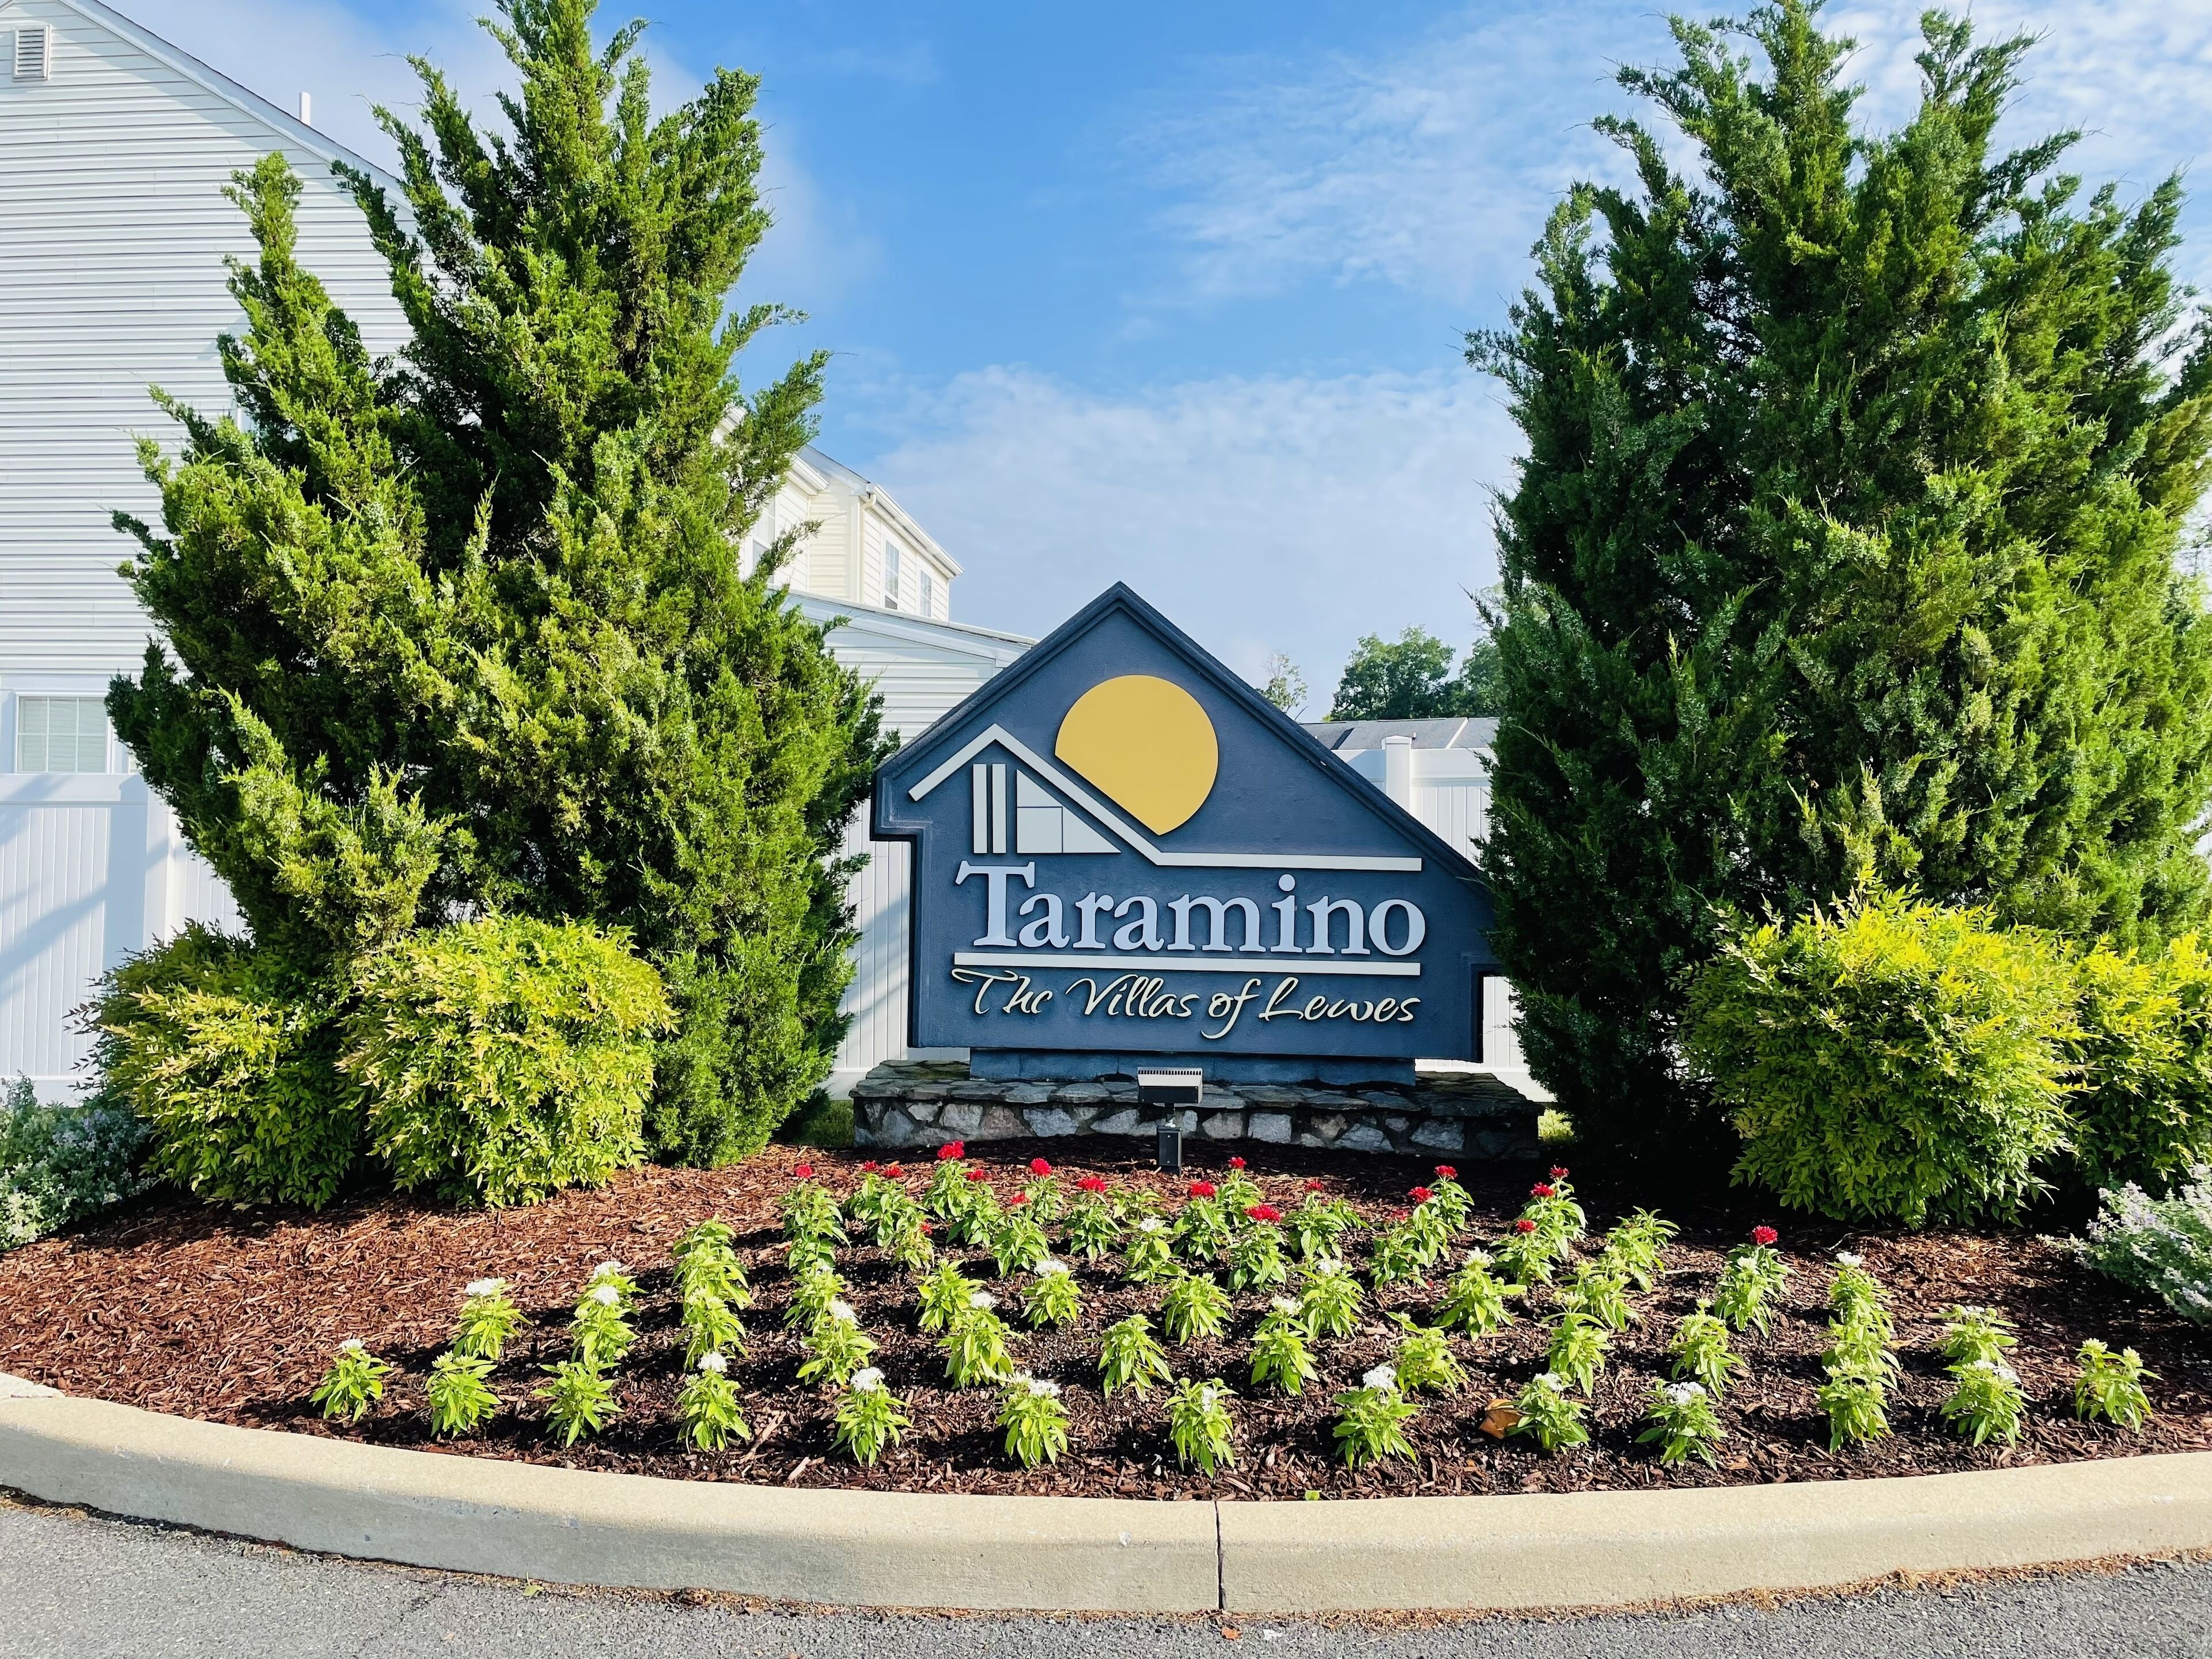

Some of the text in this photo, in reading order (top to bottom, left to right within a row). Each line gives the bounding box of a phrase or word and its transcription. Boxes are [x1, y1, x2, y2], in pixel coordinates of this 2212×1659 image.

[955, 860, 1426, 956] Taramino
[951, 968, 1421, 1039] The Villas of Lewes
